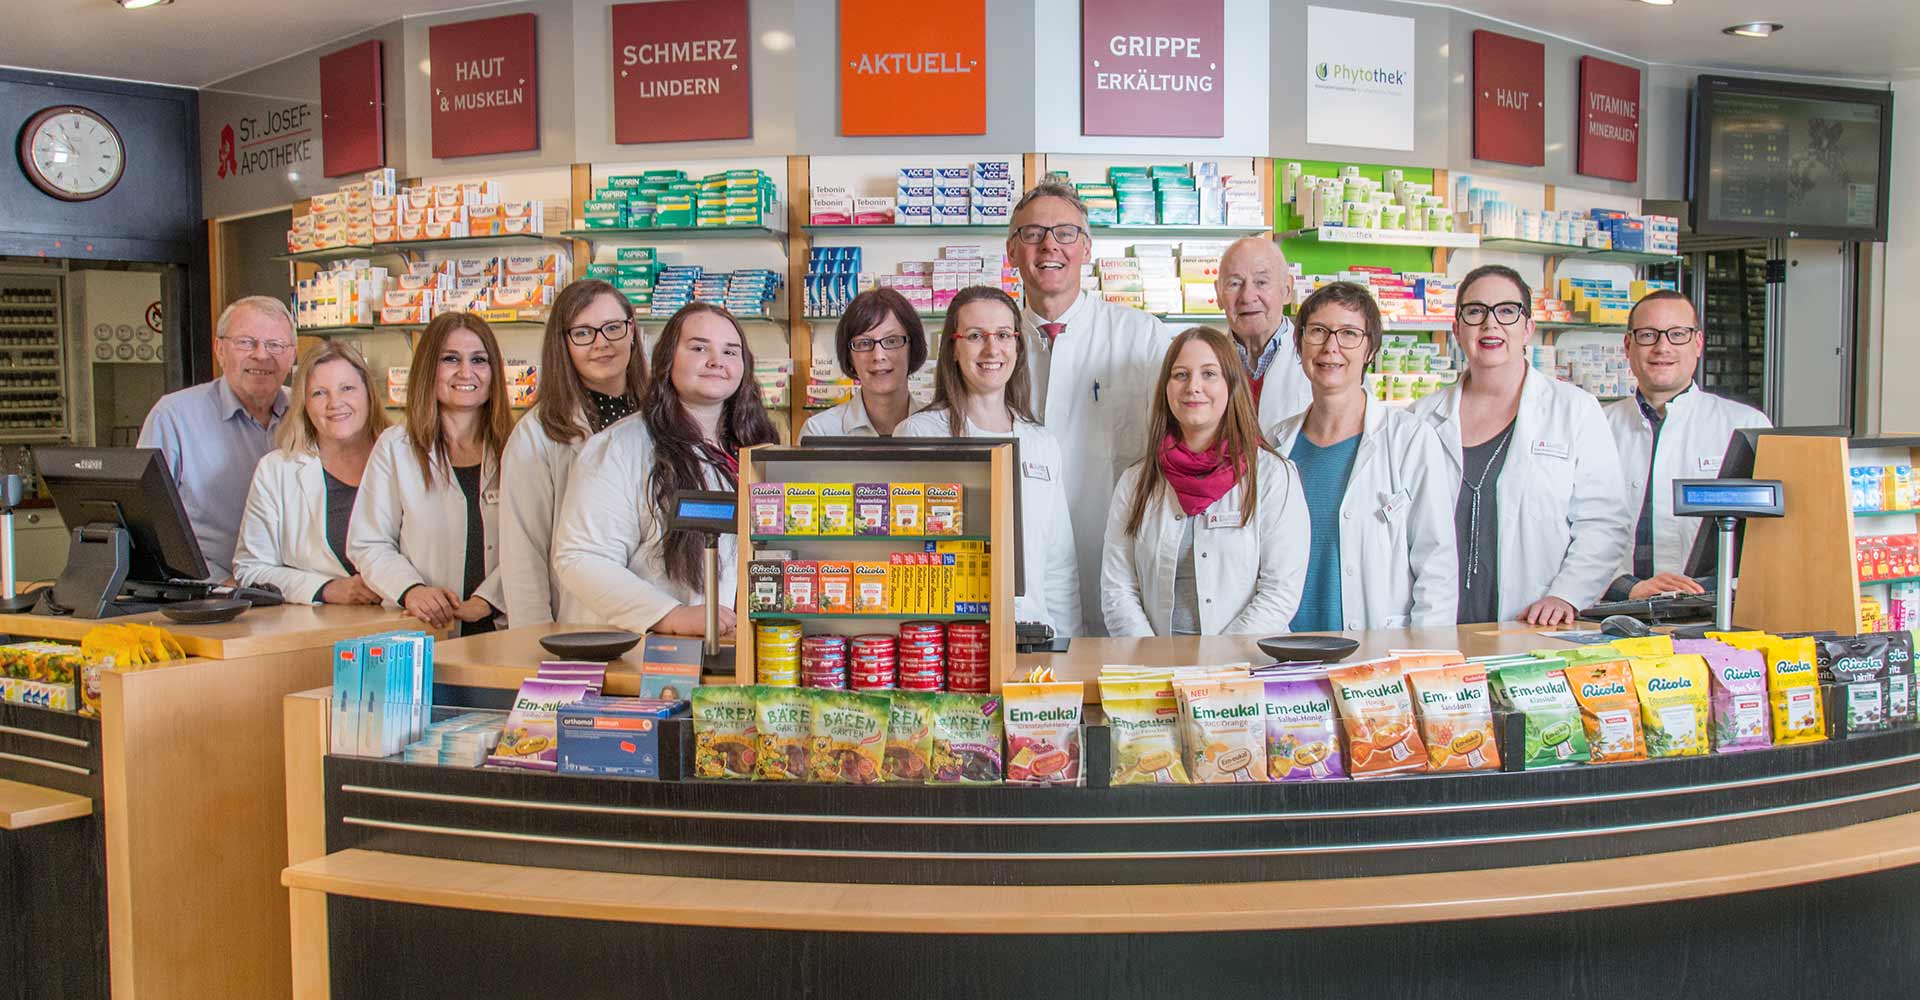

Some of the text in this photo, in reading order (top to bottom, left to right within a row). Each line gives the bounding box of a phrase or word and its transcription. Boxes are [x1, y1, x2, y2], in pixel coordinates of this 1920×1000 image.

[623, 39, 738, 66] SCHMERZ
[1109, 36, 1201, 58] GRIPPE
[456, 57, 505, 82] HAUT
[857, 52, 971, 75] AKTUELL
[1097, 69, 1213, 92] ERKÄLTUNG
[640, 78, 720, 98] LINDERN
[440, 88, 523, 112] & MUSKELN
[1496, 88, 1529, 111] HAUT
[1590, 91, 1636, 119] VITAMINE
[240, 105, 311, 142] ST. JOSEF-
[1589, 121, 1635, 143] MINERALIEN
[241, 139, 311, 175] APOTHEKE
[615, 179, 639, 188] ASPIRIN
[816, 185, 846, 193] Tebonin
[602, 190, 627, 199] ASPIRIN
[591, 203, 615, 211] ASPIRIN
[857, 198, 886, 206] Tebonin
[593, 266, 617, 274] ASPIRIN
[1101, 260, 1137, 268] Lemocin
[1104, 272, 1139, 281] Lemocin
[1105, 294, 1140, 302] Lemocin
[815, 358, 833, 366] Talcid
[752, 488, 780, 496] Ricola
[787, 488, 816, 496] Ricola
[822, 488, 851, 496] Ricola
[857, 487, 887, 496] Ricola
[892, 487, 921, 496] Ricola
[927, 488, 957, 496] Ricola
[751, 565, 780, 574] Ricola
[786, 565, 815, 574] Ricola
[821, 565, 850, 574] Ricola
[856, 566, 885, 574] Ricola
[1777, 660, 1811, 674] Ricola
[1839, 658, 1881, 671] Ricola
[1724, 668, 1760, 680] Ricola
[1342, 681, 1404, 700] Em-eukal
[1582, 682, 1625, 697] Ricola
[1648, 677, 1691, 692] Ricola
[1190, 689, 1208, 698] NEU
[1193, 703, 1259, 719] Em-eukal
[1265, 699, 1330, 715] Em-eukal
[1441, 703, 1471, 711] Sanddorn
[704, 706, 756, 721] BÄREN
[768, 708, 810, 723] BÄRE
[1010, 707, 1077, 721] Em-eukal
[564, 718, 593, 727] orthomol
[823, 712, 876, 732] BÄREN
[1112, 717, 1176, 730] Em-eukal
[831, 727, 864, 738] GARTEN
